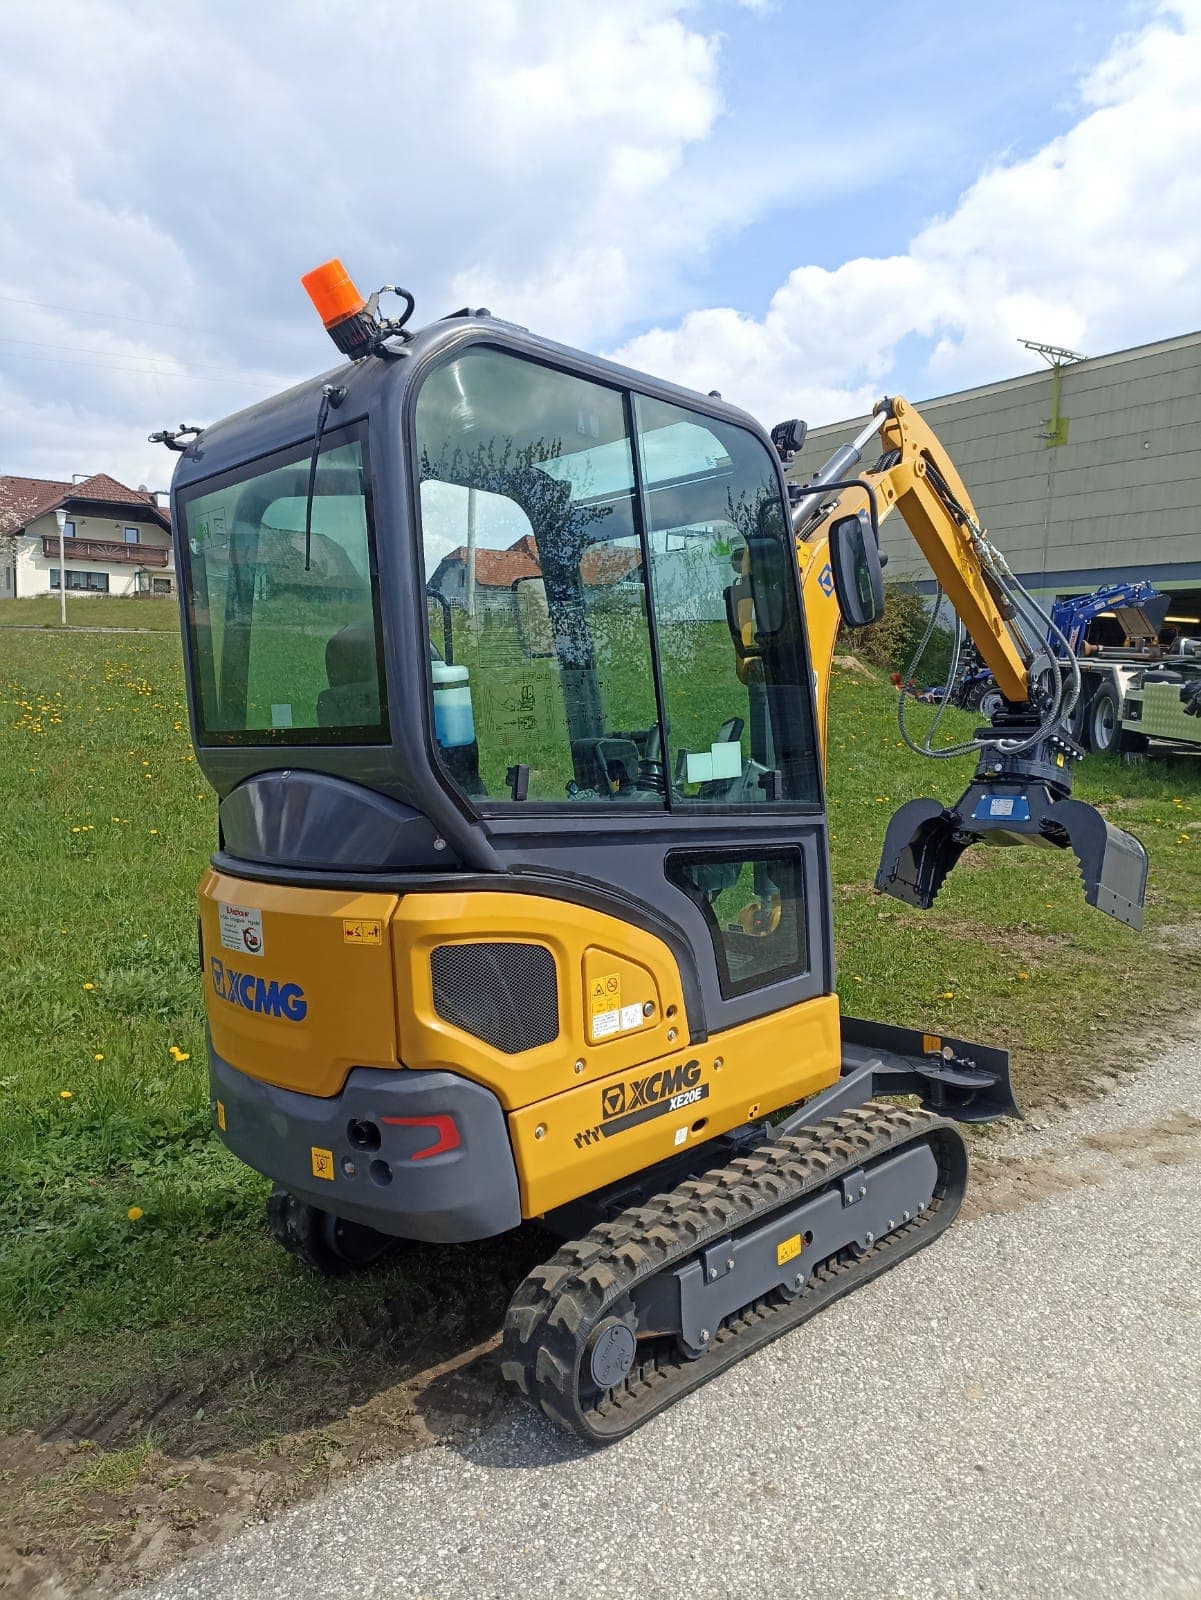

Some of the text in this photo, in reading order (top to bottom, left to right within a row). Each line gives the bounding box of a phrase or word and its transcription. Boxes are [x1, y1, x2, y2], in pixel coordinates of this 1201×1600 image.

[225, 968, 307, 1022] XCMG
[626, 1059, 701, 1111] XCMG
[668, 1087, 703, 1111] XE20E
